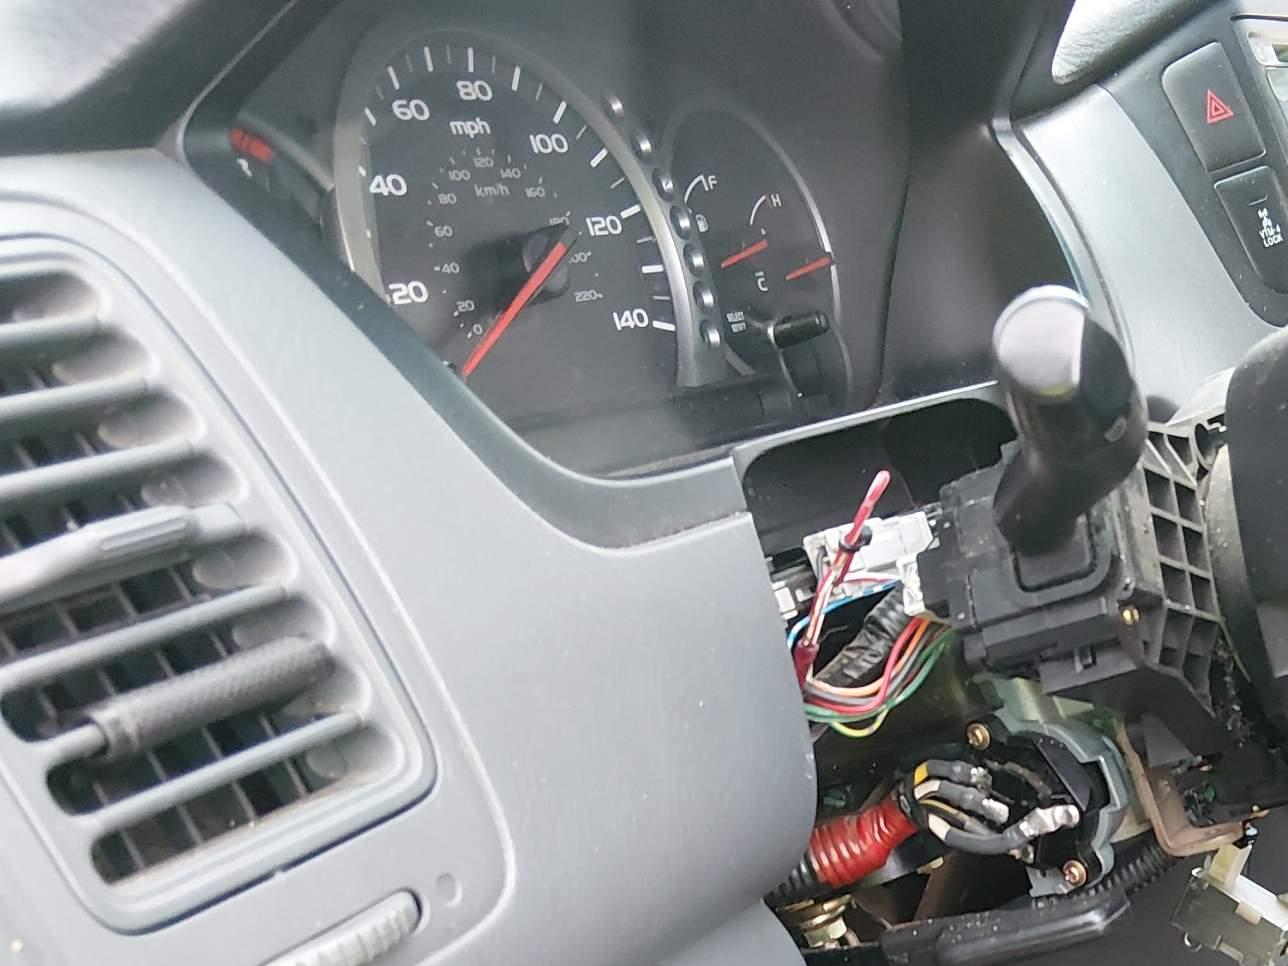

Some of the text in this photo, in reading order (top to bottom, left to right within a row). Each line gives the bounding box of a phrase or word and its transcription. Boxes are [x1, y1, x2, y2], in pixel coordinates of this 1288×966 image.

[456, 80, 493, 101] 80
[392, 99, 430, 121] 60
[450, 117, 491, 138] mph
[529, 133, 568, 154] 100
[472, 155, 494, 168] 120
[449, 169, 471, 181] 100
[500, 167, 521, 179] 140
[369, 174, 407, 196] 40
[707, 175, 718, 190] F
[474, 184, 510, 198] km/h
[770, 193, 782, 207] H
[434, 225, 453, 238] 60
[586, 215, 623, 236] 120
[1263, 234, 1284, 248] LOCK
[441, 262, 460, 274] 40
[757, 277, 769, 292] C
[388, 280, 428, 305] 20
[456, 300, 475, 311] 20
[612, 308, 649, 330] 140
[472, 324, 484, 335] 0
